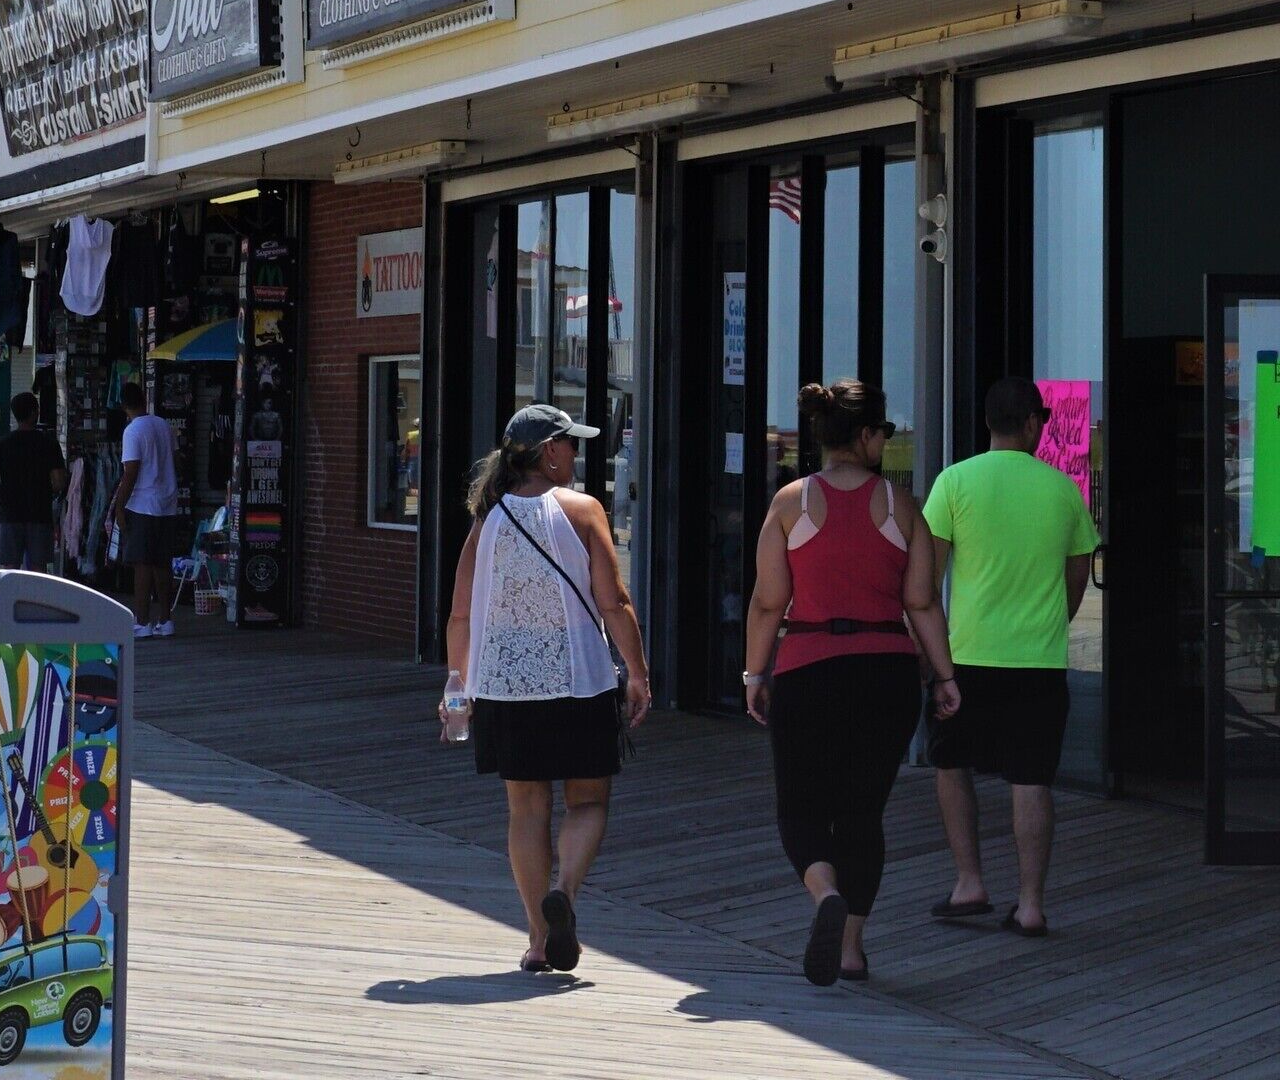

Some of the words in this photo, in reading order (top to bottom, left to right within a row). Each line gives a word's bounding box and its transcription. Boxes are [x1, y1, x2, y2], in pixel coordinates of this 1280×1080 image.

[158, 49, 196, 85] CLOTHING
[203, 38, 228, 68] GIFTS
[39, 102, 90, 146] CUSTOM
[57, 766, 81, 785] PRZE
[85, 750, 96, 776] PRIZE
[94, 815, 105, 841] PRIZE
